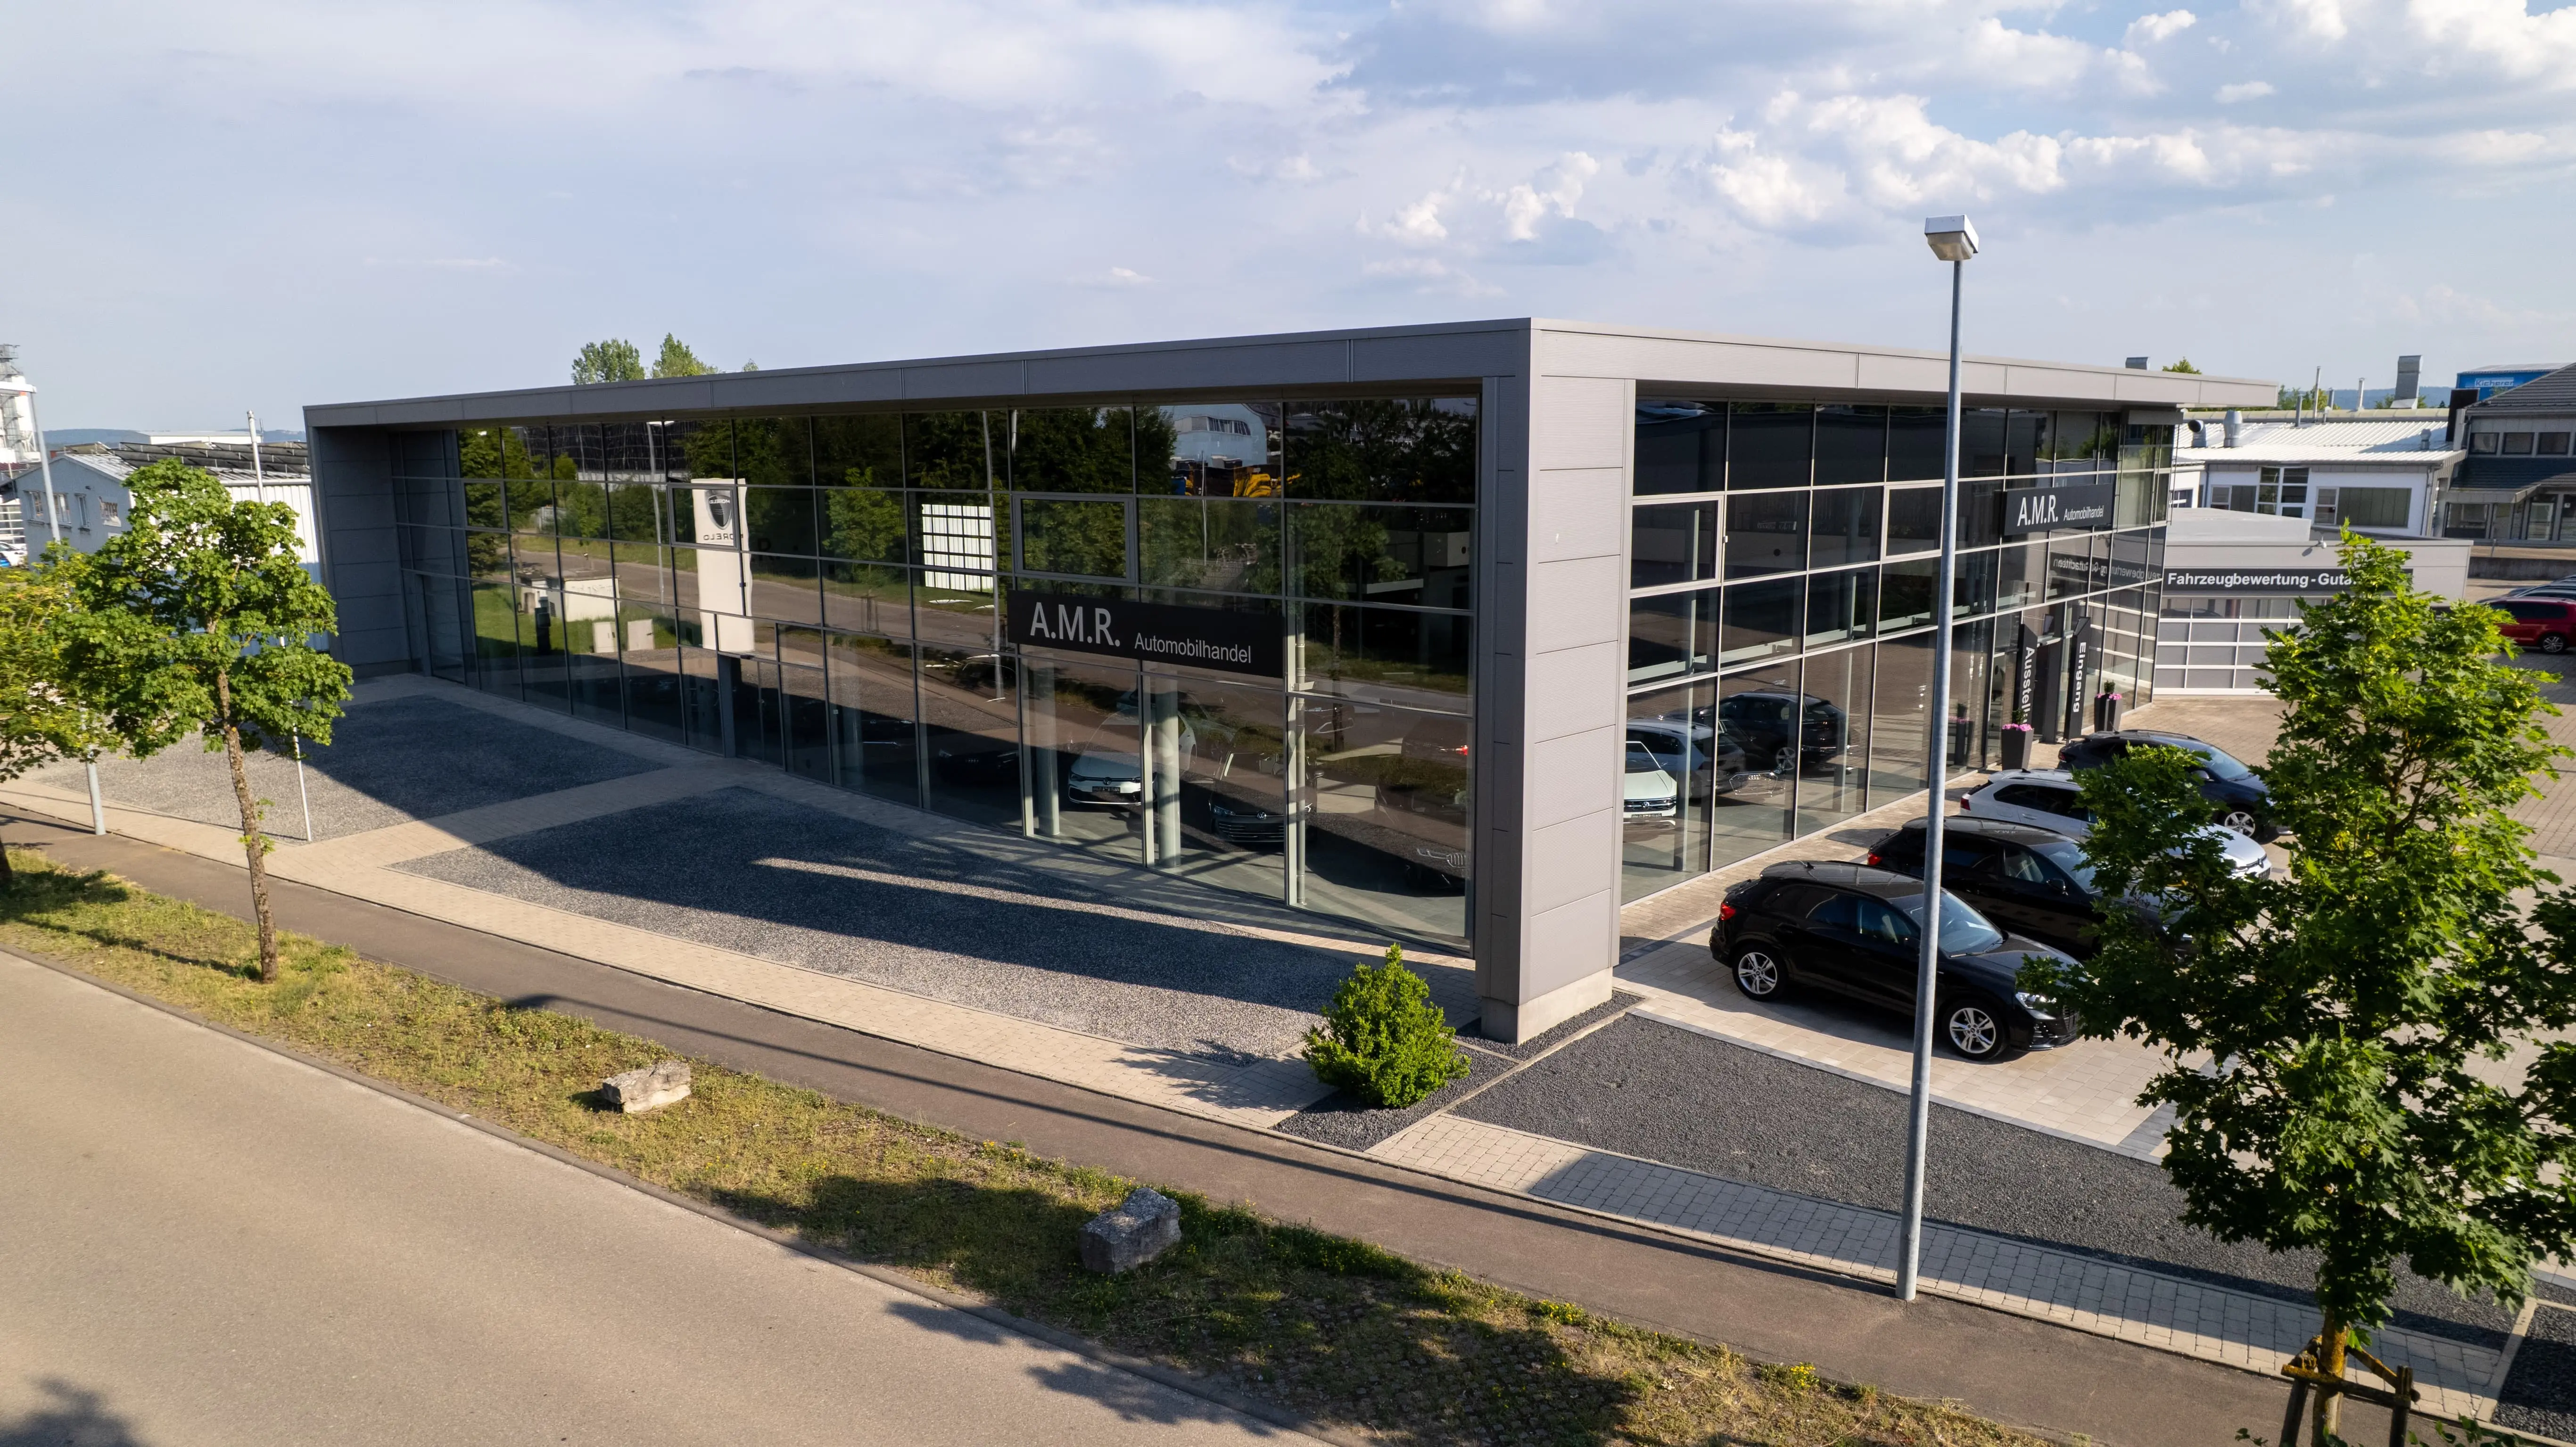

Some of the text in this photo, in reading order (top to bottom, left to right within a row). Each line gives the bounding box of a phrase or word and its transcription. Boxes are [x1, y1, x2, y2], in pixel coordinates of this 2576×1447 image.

[2017, 495, 2104, 526] A.M.R. Automobilhandel
[2168, 573, 2308, 587] Fahrzeugbewertung
[1030, 602, 1251, 664] A.M.R. Automobilhandel
[2022, 647, 2035, 723] Ausstell
[2073, 642, 2086, 712] Eingang
